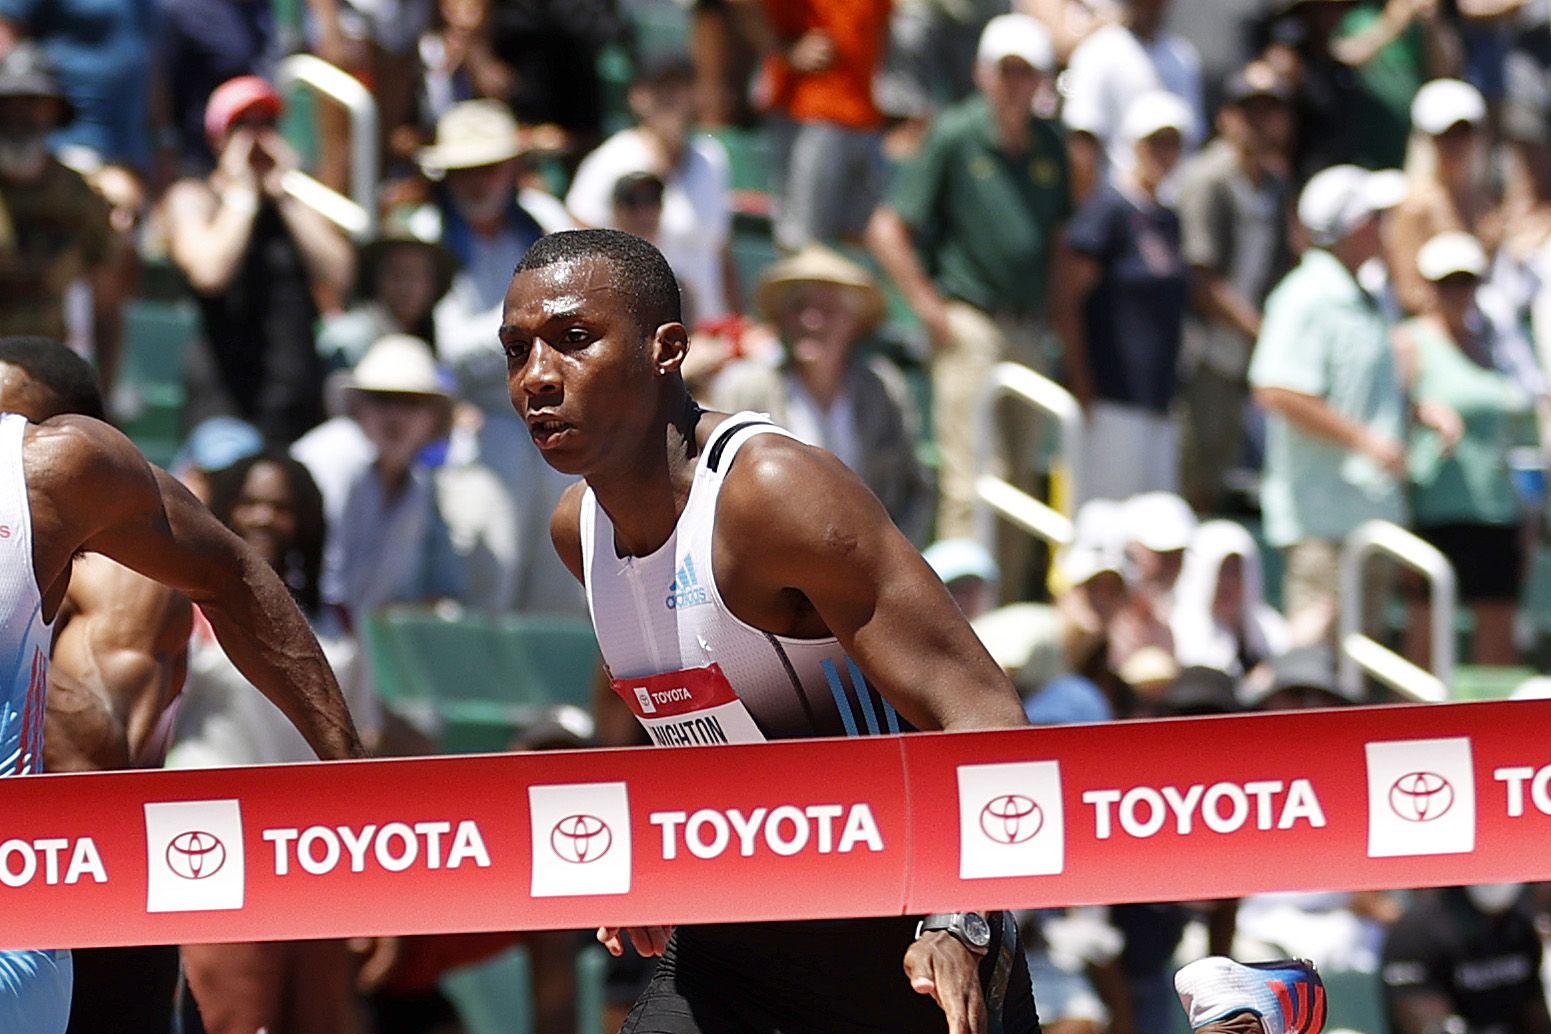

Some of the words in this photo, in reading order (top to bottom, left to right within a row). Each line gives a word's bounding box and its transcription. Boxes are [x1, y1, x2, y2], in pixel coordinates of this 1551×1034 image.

[651, 687, 692, 705] TOYOTA
[263, 821, 491, 875] TOYOTA
[650, 804, 884, 859] TOYOTA
[1083, 779, 1326, 838] TOYOTA
